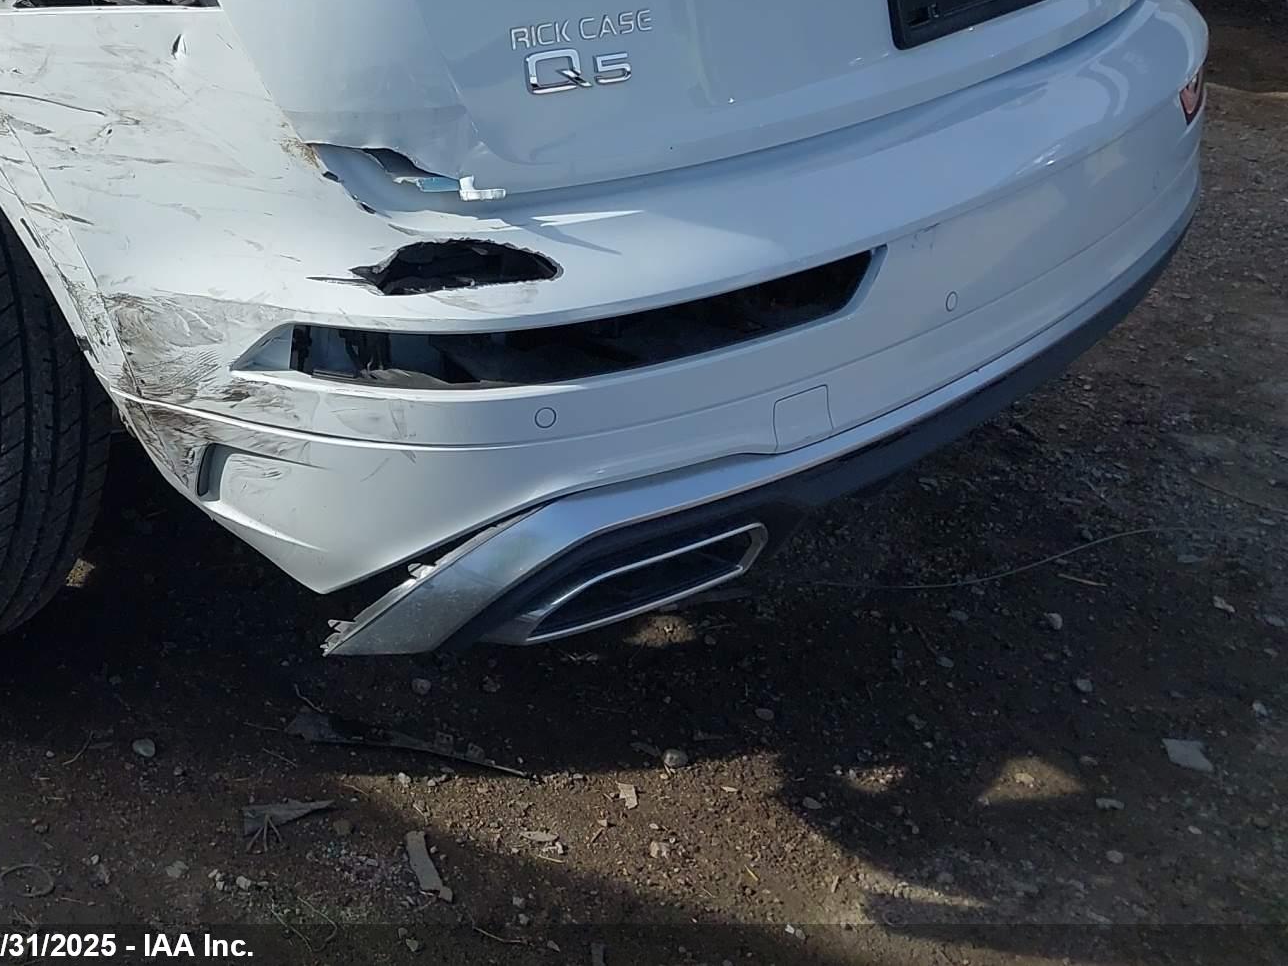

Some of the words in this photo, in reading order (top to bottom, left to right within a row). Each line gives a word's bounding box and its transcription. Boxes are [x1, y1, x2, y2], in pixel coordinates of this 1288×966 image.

[510, 19, 571, 50] RICK
[578, 9, 653, 40] CASE
[525, 48, 632, 94] Q5
